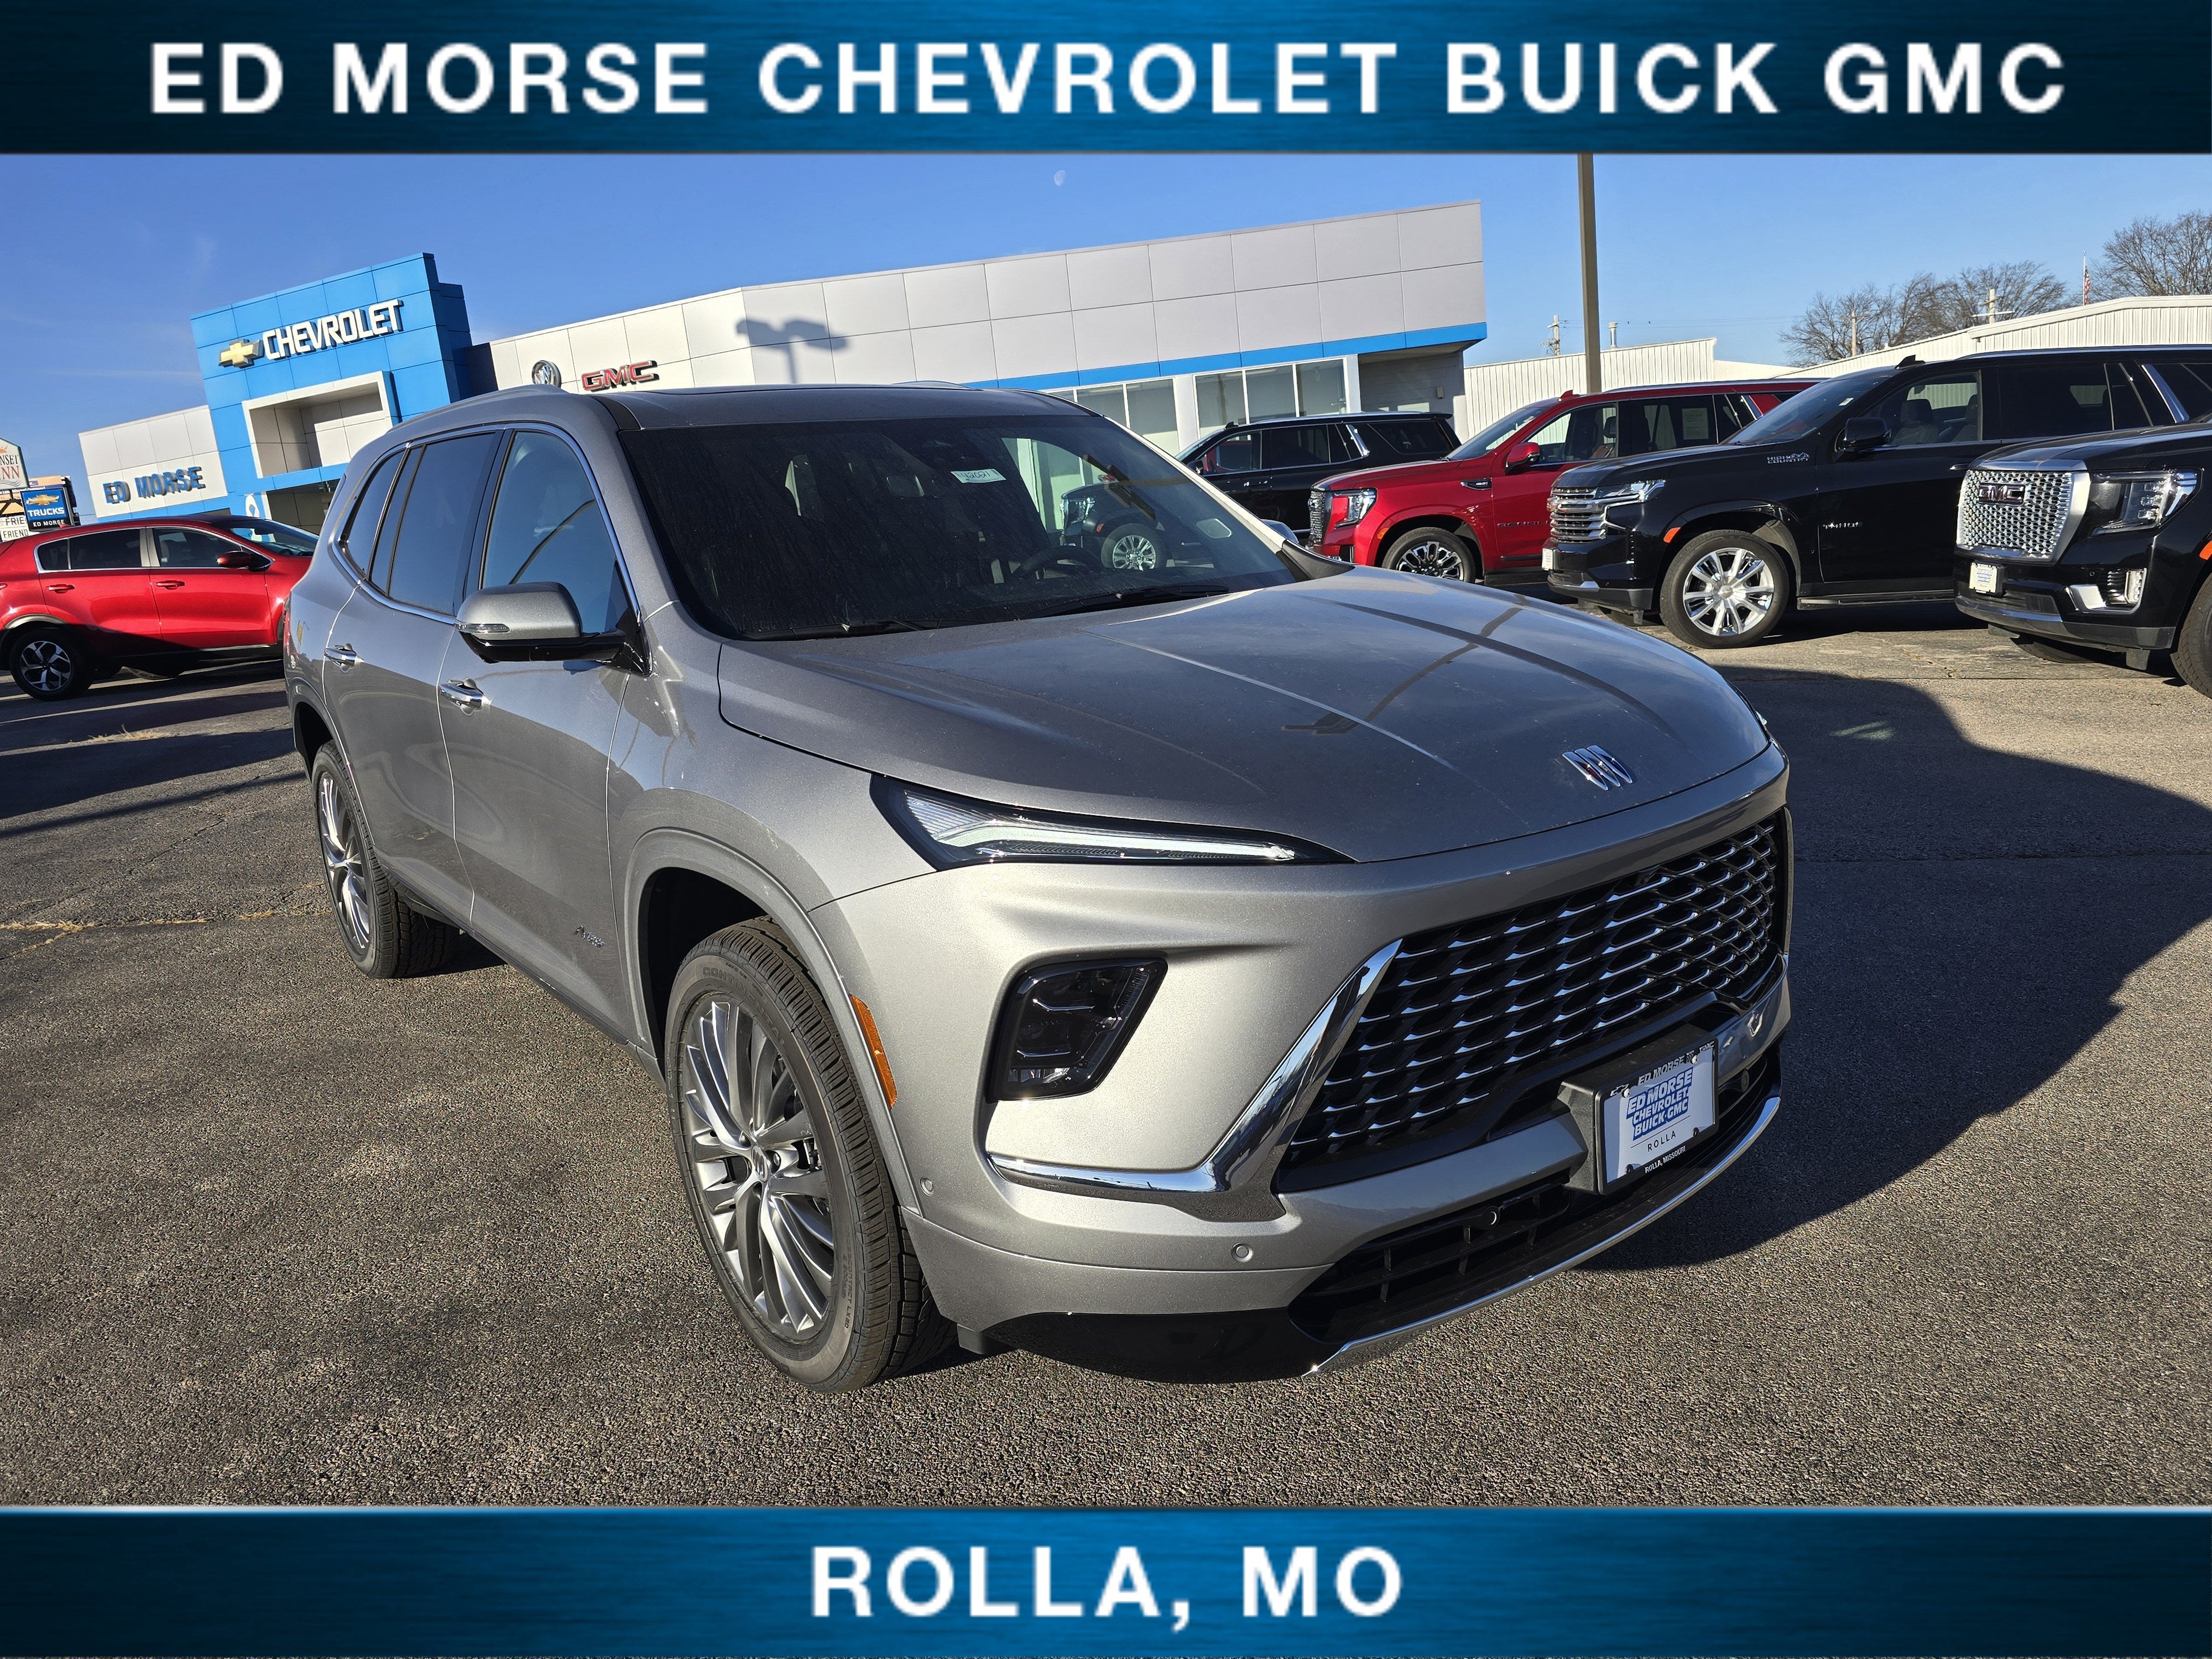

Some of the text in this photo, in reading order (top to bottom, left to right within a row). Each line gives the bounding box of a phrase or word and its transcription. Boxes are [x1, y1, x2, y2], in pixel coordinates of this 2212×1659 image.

[262, 299, 401, 360] CHEVROLET
[581, 360, 655, 390] GMC
[0, 466, 19, 479] NN
[103, 466, 205, 504] ED MORSE
[1979, 484, 2024, 502] GMC
[6, 516, 27, 526] FRIE
[28, 507, 65, 518] TRUCKS
[1699, 1041, 1715, 1053] GMC
[1637, 1056, 1686, 1086] ED MORSE
[1627, 1068, 1693, 1115] ED MORSE
[1632, 1087, 1688, 1123] CHEVROLET
[1647, 1130, 1676, 1152] ROLLA
[1645, 1145, 1686, 1173] ROLLA, MISSOURI
